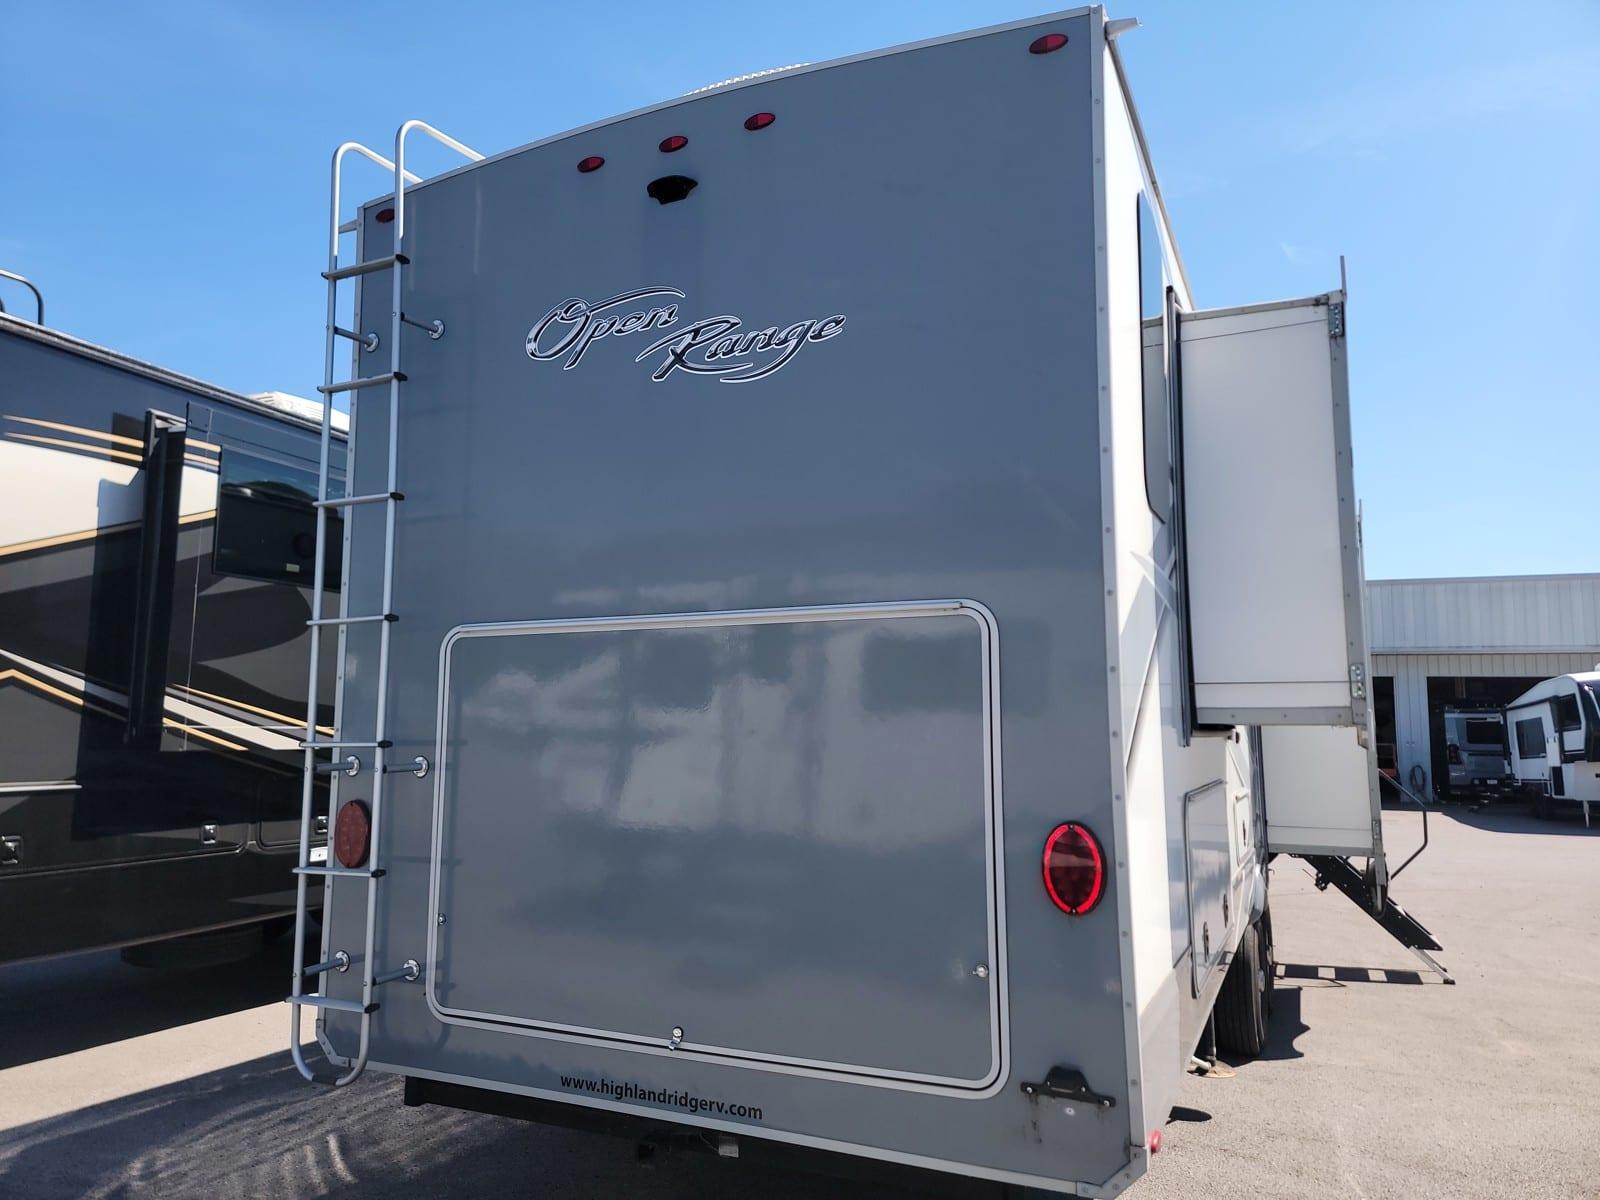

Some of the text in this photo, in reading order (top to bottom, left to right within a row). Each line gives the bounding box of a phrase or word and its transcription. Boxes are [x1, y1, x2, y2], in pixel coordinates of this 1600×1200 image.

[525, 285, 846, 383] Open Range
[560, 1075, 763, 1120] www.highlandridgerv.com
